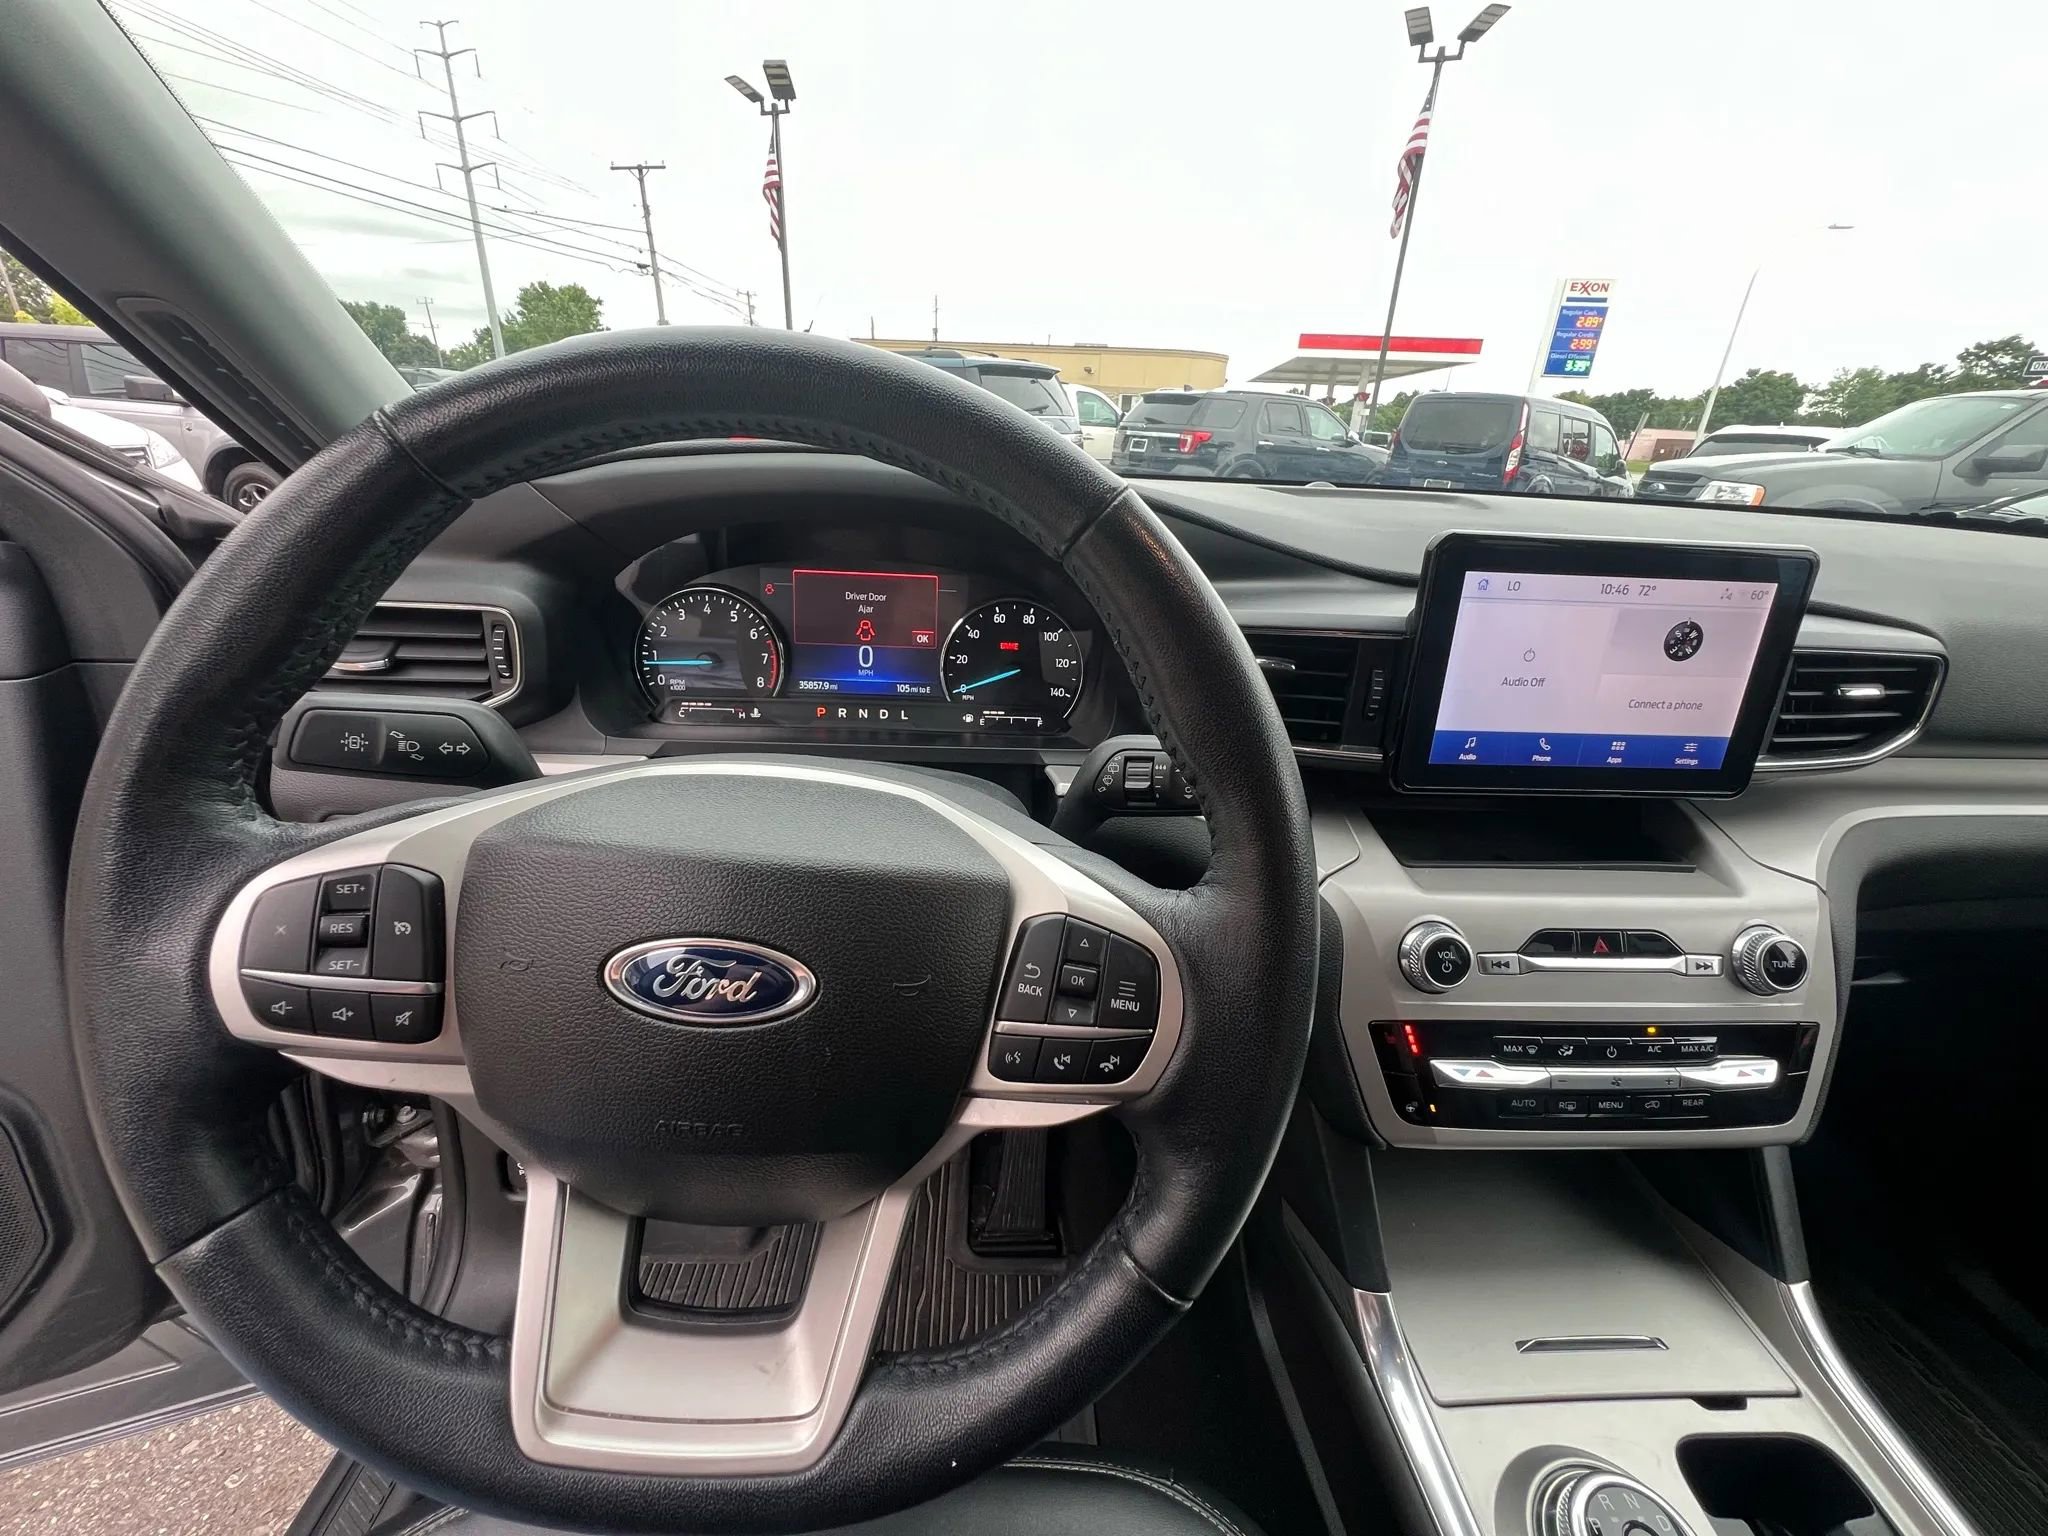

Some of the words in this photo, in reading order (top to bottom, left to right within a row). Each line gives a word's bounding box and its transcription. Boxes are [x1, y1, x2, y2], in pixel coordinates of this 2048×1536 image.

[1507, 581, 1521, 591] LO
[1600, 583, 1630, 596] 10:46
[845, 592, 867, 601] Driver
[868, 593, 886, 602] Door
[703, 603, 711, 614] 4
[858, 604, 874, 614] Ajar
[678, 609, 685, 620] 3
[730, 611, 738, 622] 5
[993, 614, 1006, 624] 60
[1023, 615, 1035, 624] 80
[660, 626, 667, 637] 2
[750, 629, 758, 640] 6
[967, 629, 980, 639] 40
[1044, 632, 1059, 641] 100
[1675, 630, 1682, 638] S
[1689, 630, 1699, 639] W
[917, 635, 928, 643] OK
[653, 650, 657, 661] 1
[1685, 646, 1693, 655] N
[761, 653, 768, 664] 7
[858, 645, 873, 668] 0
[956, 655, 968, 664] 20
[1055, 659, 1069, 668] 120
[657, 674, 665, 685] 0
[757, 677, 765, 688] 8
[1501, 677, 1528, 687] Audio
[1530, 677, 1546, 687] Off
[799, 681, 829, 690] 35857.9
[896, 684, 910, 693] 105
[960, 684, 967, 693] 0
[1050, 688, 1065, 697] 140
[1628, 699, 1666, 710] Connect
[1673, 700, 1703, 712] phone
[678, 710, 685, 718] C
[817, 707, 826, 717] P
[838, 708, 847, 718] R
[859, 709, 868, 718] N
[880, 709, 888, 719] D
[901, 710, 908, 720] L
[1458, 753, 1477, 761] Audio
[1532, 754, 1551, 762] Phone
[1607, 756, 1622, 765] Apps
[1674, 758, 1699, 766] Settings
[329, 924, 353, 934] RES
[1437, 951, 1456, 959] VOL
[1771, 960, 1796, 968] TUNE
[652, 954, 762, 1003] Ford
[1071, 975, 1085, 986] OK
[1018, 983, 1043, 996] BACK
[1110, 999, 1140, 1012] MENU
[1503, 1045, 1523, 1053] MAX
[1648, 1045, 1662, 1053] A/C
[1681, 1045, 1699, 1053] MAX
[1700, 1045, 1714, 1053] A/C
[1511, 1099, 1536, 1107] AUTO
[1559, 1101, 1566, 1109] R
[1682, 1099, 1704, 1107] REAR
[653, 1119, 744, 1136] AIRBAG
[1598, 1494, 1615, 1511] R
[1622, 1493, 1640, 1510] N
[1588, 1517, 1600, 1535] P
[1655, 1515, 1672, 1531] D
